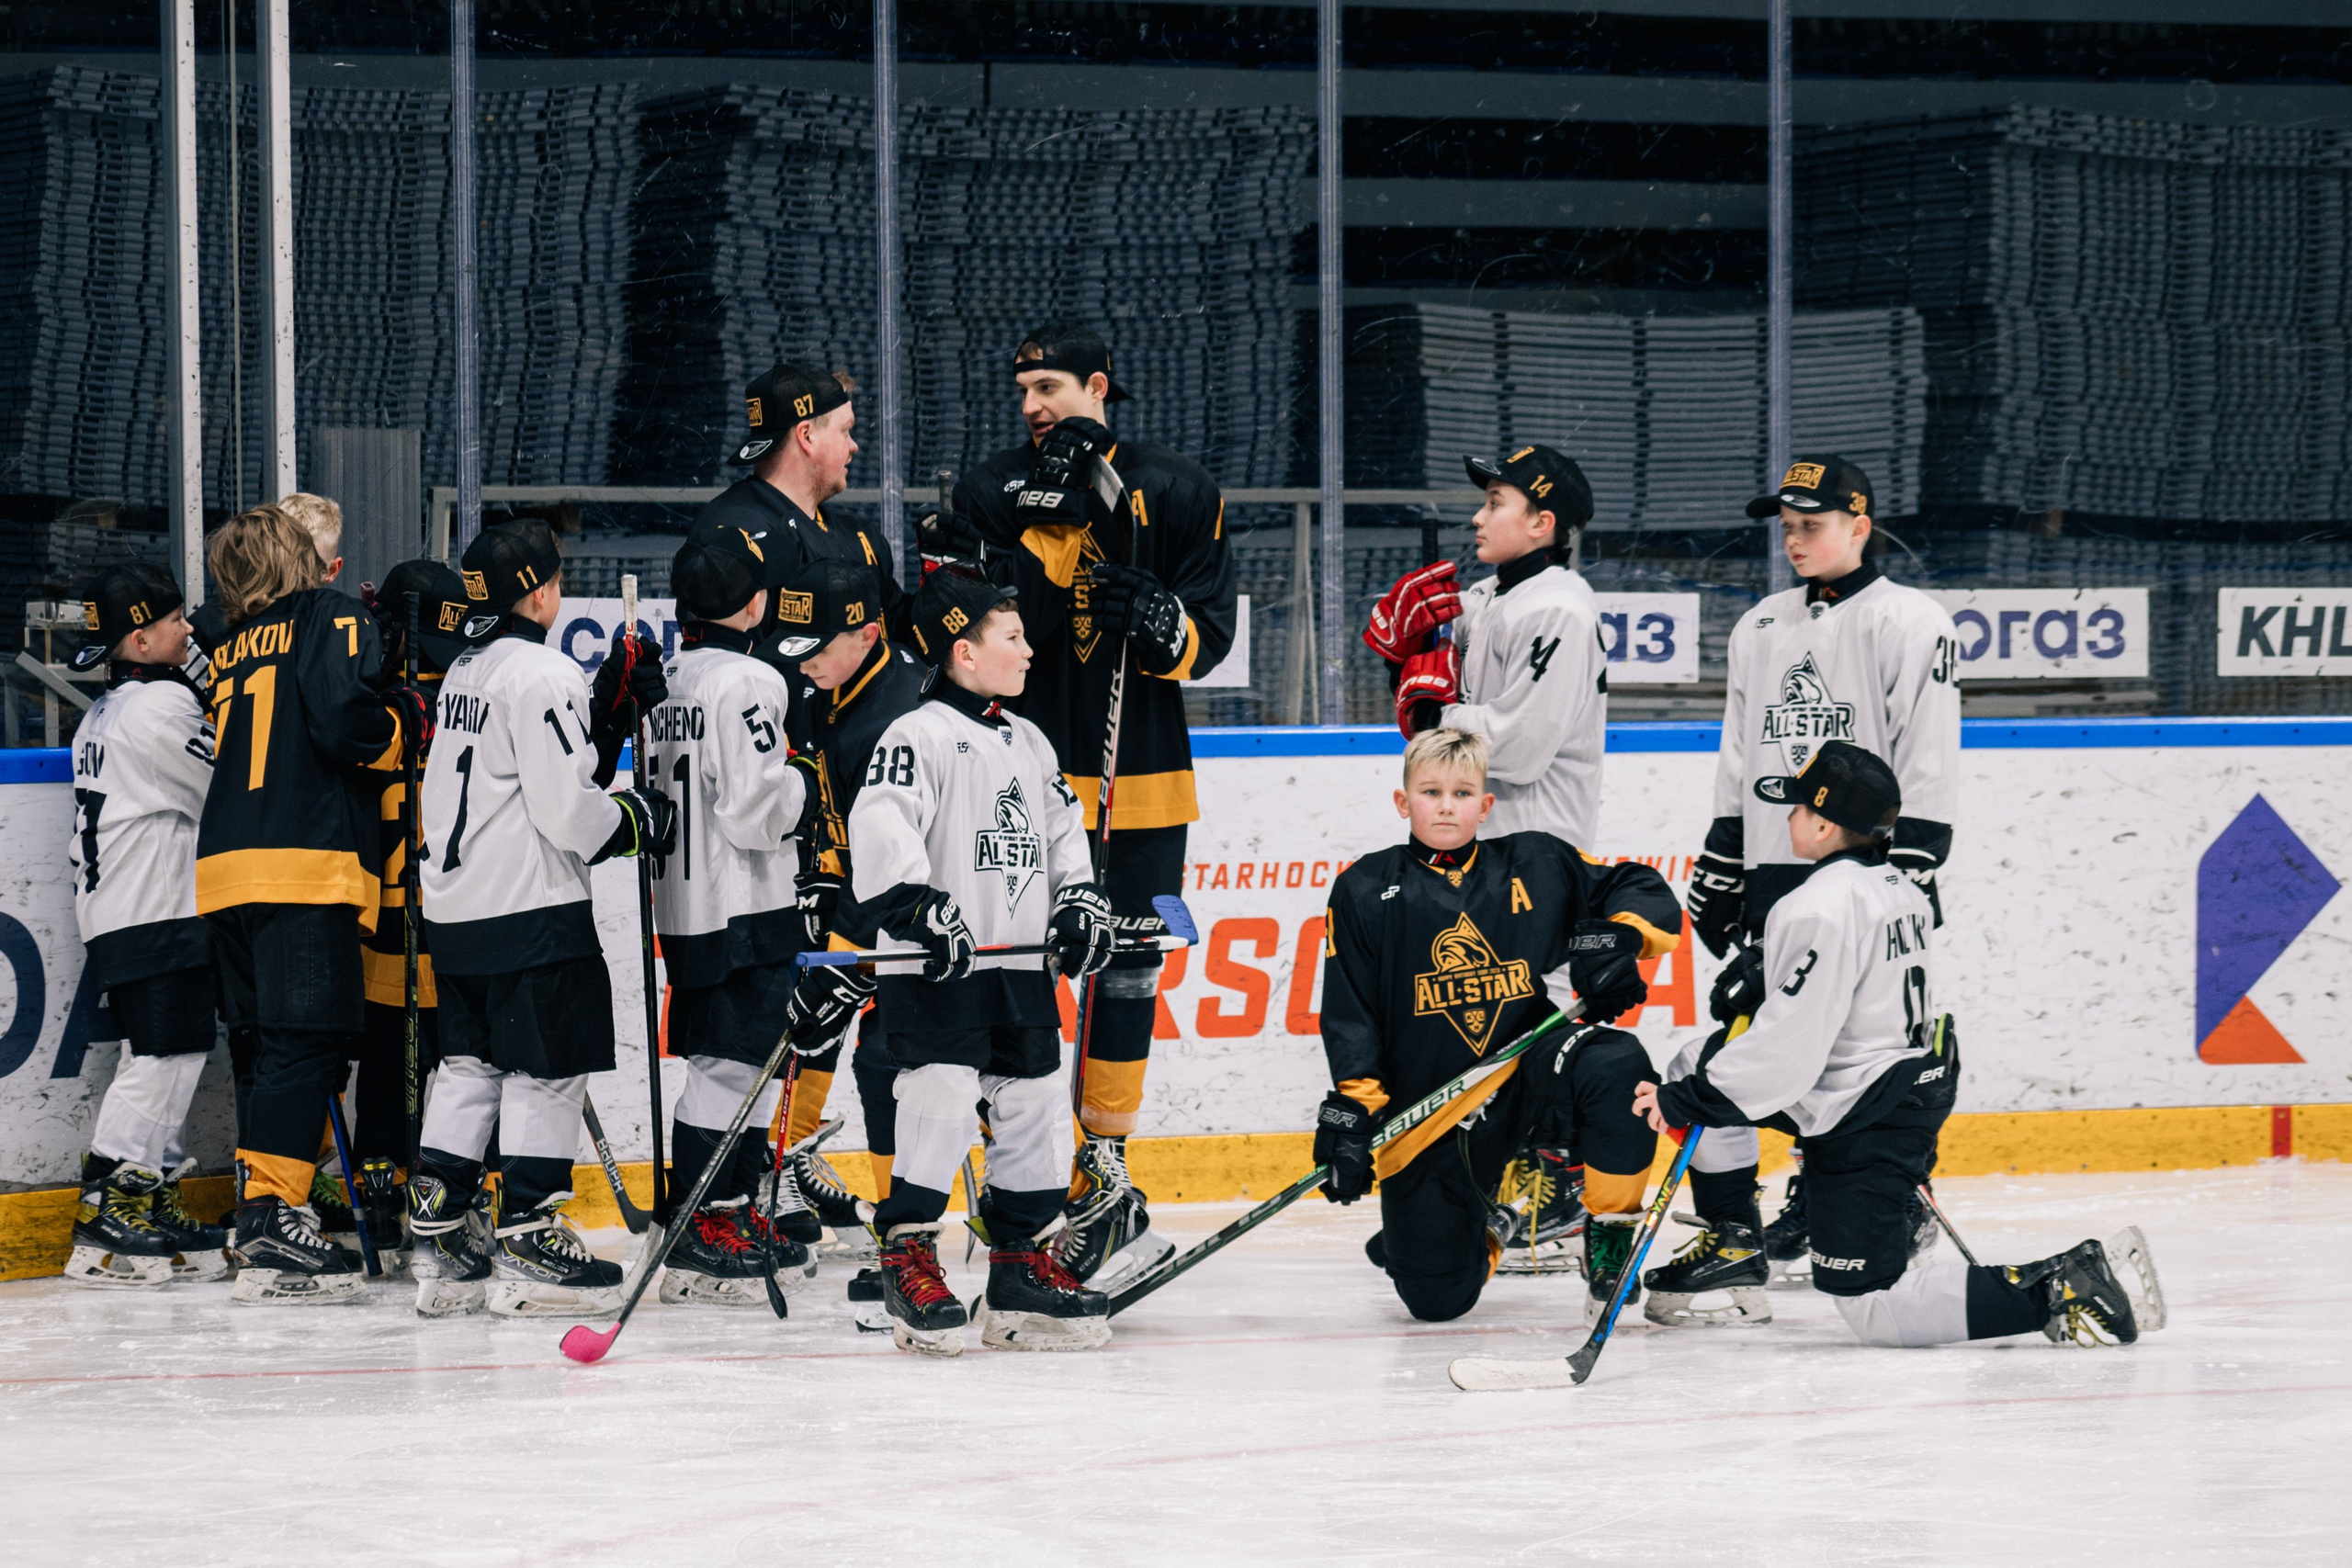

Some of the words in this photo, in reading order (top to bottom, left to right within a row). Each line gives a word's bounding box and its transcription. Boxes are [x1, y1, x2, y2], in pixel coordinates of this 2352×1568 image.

[794, 393, 814, 418] 87
[1529, 474, 1555, 499] 14
[1131, 489, 1148, 526] A
[1849, 491, 1867, 515] 38
[856, 531, 878, 566] A
[516, 565, 538, 590] 11
[130, 602, 153, 625] 81
[845, 601, 865, 625] 20
[942, 606, 969, 635] 88
[333, 616, 369, 658] 7
[2236, 605, 2352, 658] KHL
[1795, 706, 1849, 738] STAR
[1814, 786, 1829, 807] 8
[1007, 842, 1043, 869] STA
[1511, 876, 1533, 914] A
[1418, 977, 1463, 1010] ALL
[1464, 964, 1530, 1003] STAR
[501, 1249, 564, 1283] VAPOR
